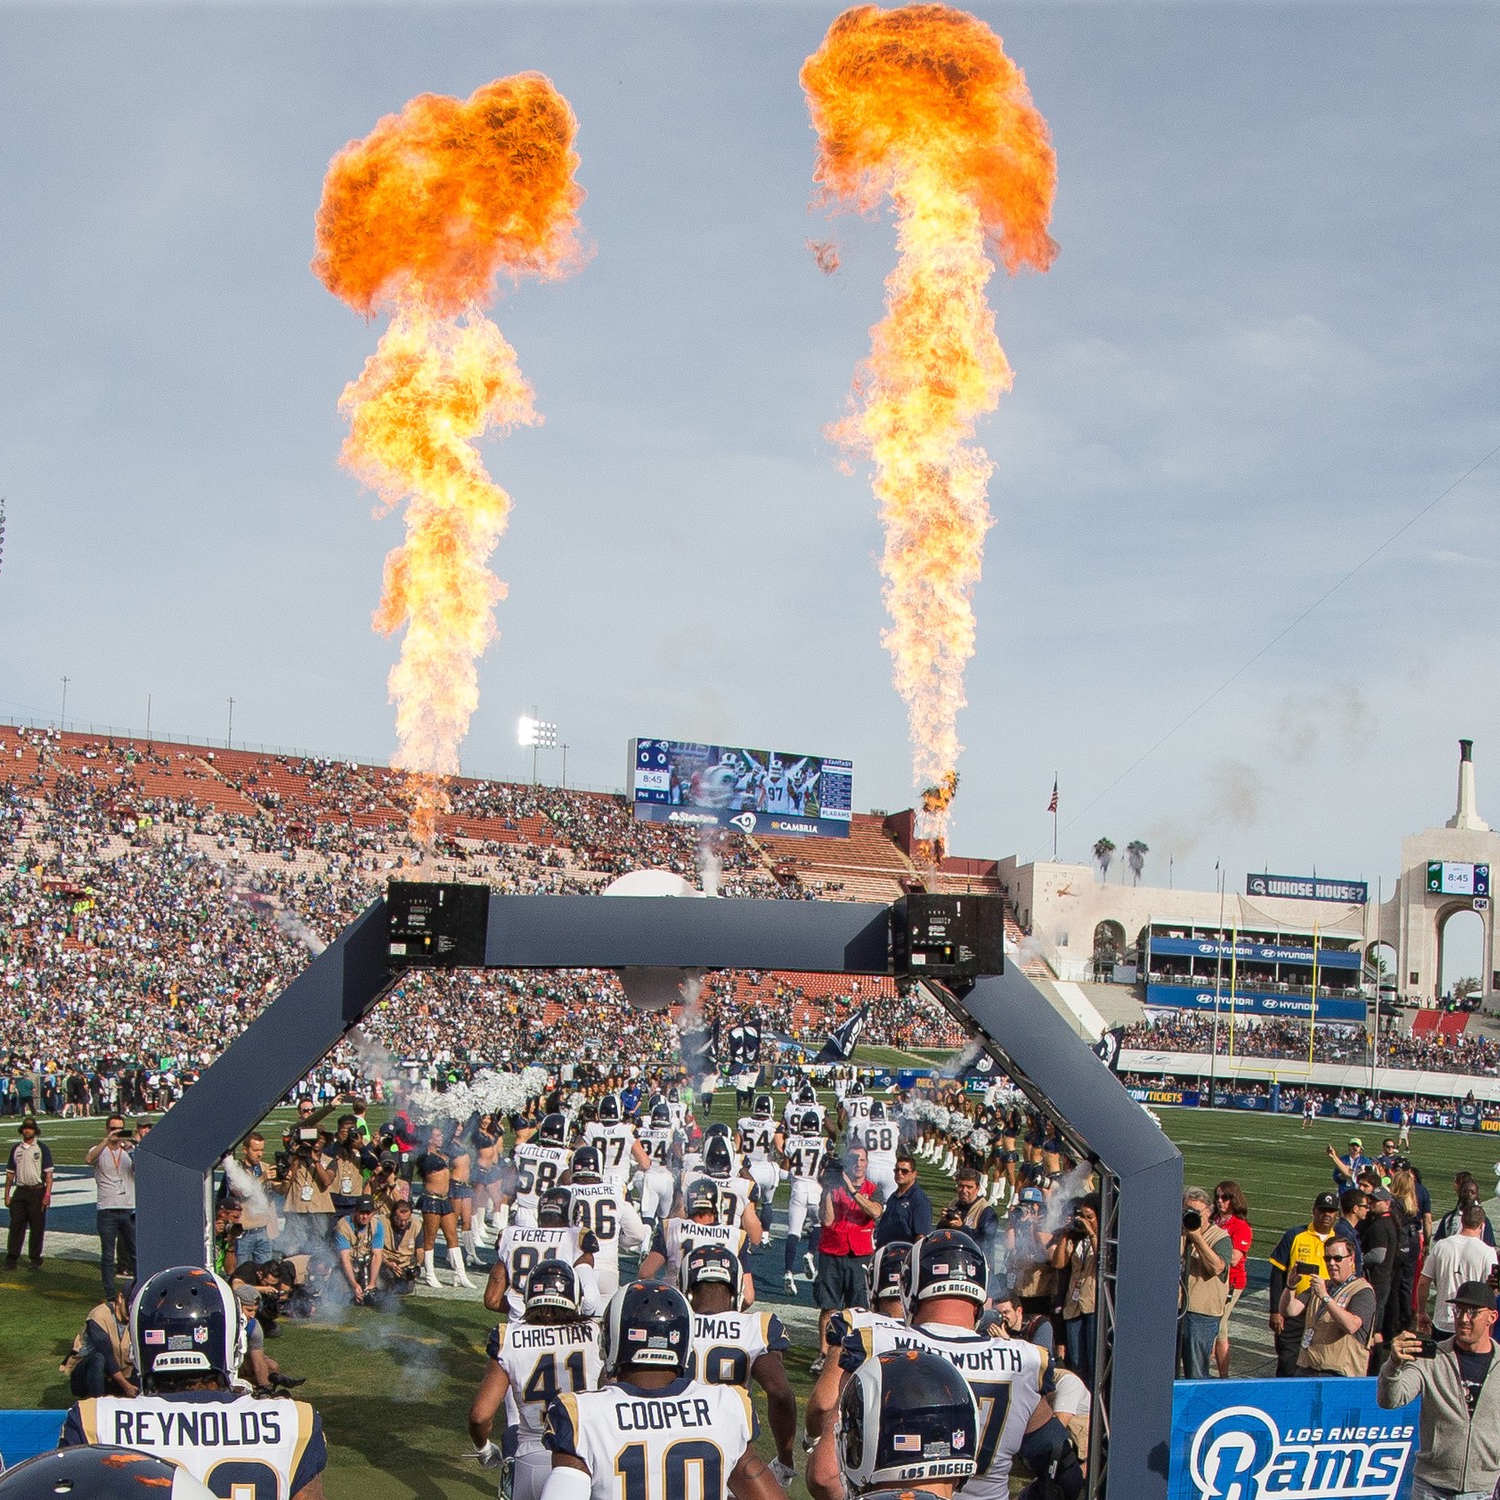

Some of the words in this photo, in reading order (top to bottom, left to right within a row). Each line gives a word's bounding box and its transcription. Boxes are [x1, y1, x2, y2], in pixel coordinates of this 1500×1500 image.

[643, 775, 662, 784] 8:45
[780, 822, 818, 834] CAMBRIA
[1448, 873, 1469, 883] 8:45
[1268, 880, 1313, 898] WHOSE
[1316, 884, 1364, 901] HOUSE?
[1215, 946, 1252, 956] HYUNDAI
[1277, 951, 1314, 960] HYUNDAI
[1214, 996, 1253, 1006] HYUNDAI
[1280, 1002, 1319, 1012] HYUNDAI
[972, 1081, 989, 1092] 1:25
[850, 1102, 868, 1118] 76
[1416, 1112, 1433, 1125] NFC
[742, 1128, 770, 1154] 54
[788, 1137, 821, 1148] PETERSON
[864, 1128, 892, 1151] 68
[519, 1147, 562, 1160] LITTLETON
[789, 1148, 820, 1177] 47
[518, 1158, 558, 1196] 58
[571, 1185, 615, 1197] ONGACRE
[512, 1229, 566, 1243] EVERETT
[681, 1222, 730, 1240] MANNION
[932, 1284, 946, 1294] LOS
[948, 1284, 979, 1296] ANGELES
[692, 1318, 741, 1340] OMAS
[512, 1325, 593, 1349] CHRISTIAN
[156, 1358, 169, 1366] LOS
[637, 1352, 650, 1361] LOS
[523, 1350, 588, 1423] 41
[615, 1398, 712, 1431] COOPER
[114, 1410, 281, 1446] REYNOLDS
[1284, 1428, 1324, 1443] LOS
[1328, 1425, 1414, 1441] ANGELES
[901, 1465, 924, 1480] LOS
[928, 1461, 974, 1478] ANGELES
